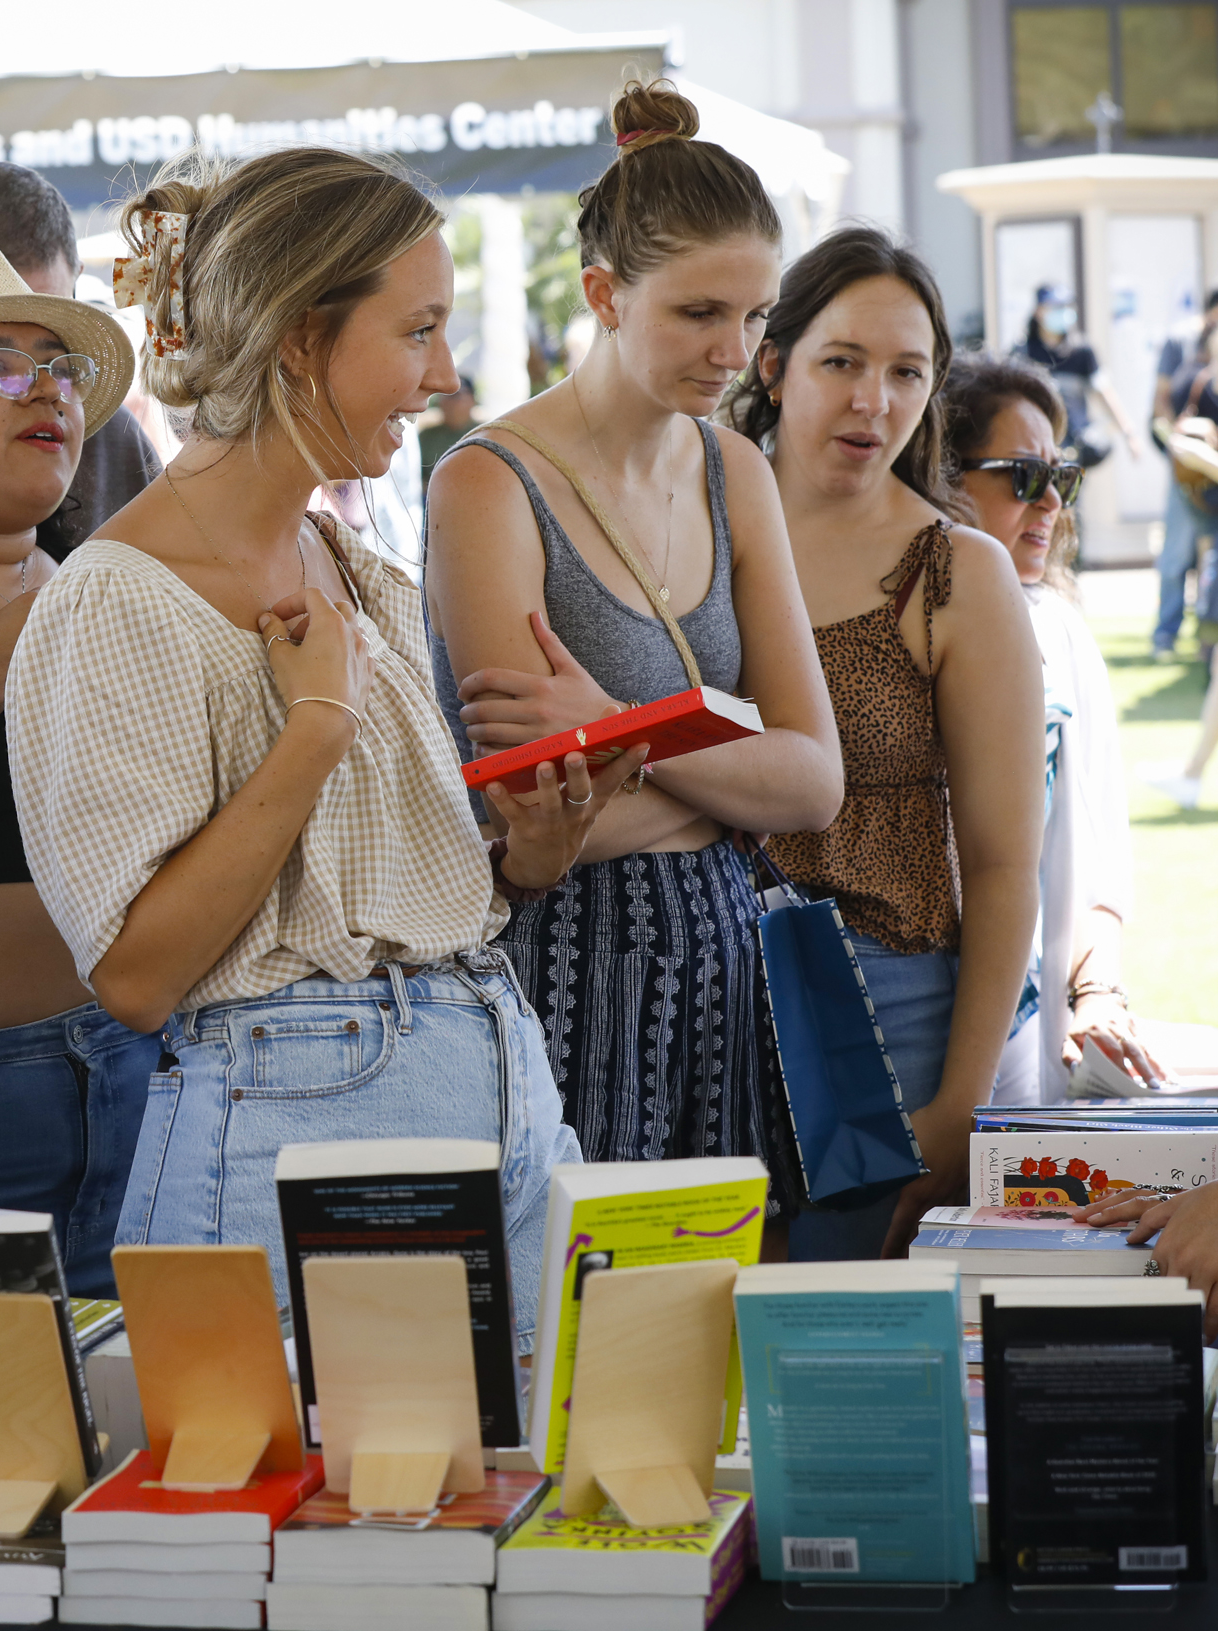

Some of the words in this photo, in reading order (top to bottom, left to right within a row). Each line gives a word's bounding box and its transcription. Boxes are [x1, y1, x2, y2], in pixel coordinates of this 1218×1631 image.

[8, 118, 94, 168] and
[96, 115, 195, 166] USD
[196, 106, 448, 160] Humanities
[449, 100, 603, 152] Center
[988, 1147, 999, 1174] KALI
[1170, 1168, 1185, 1182] &
